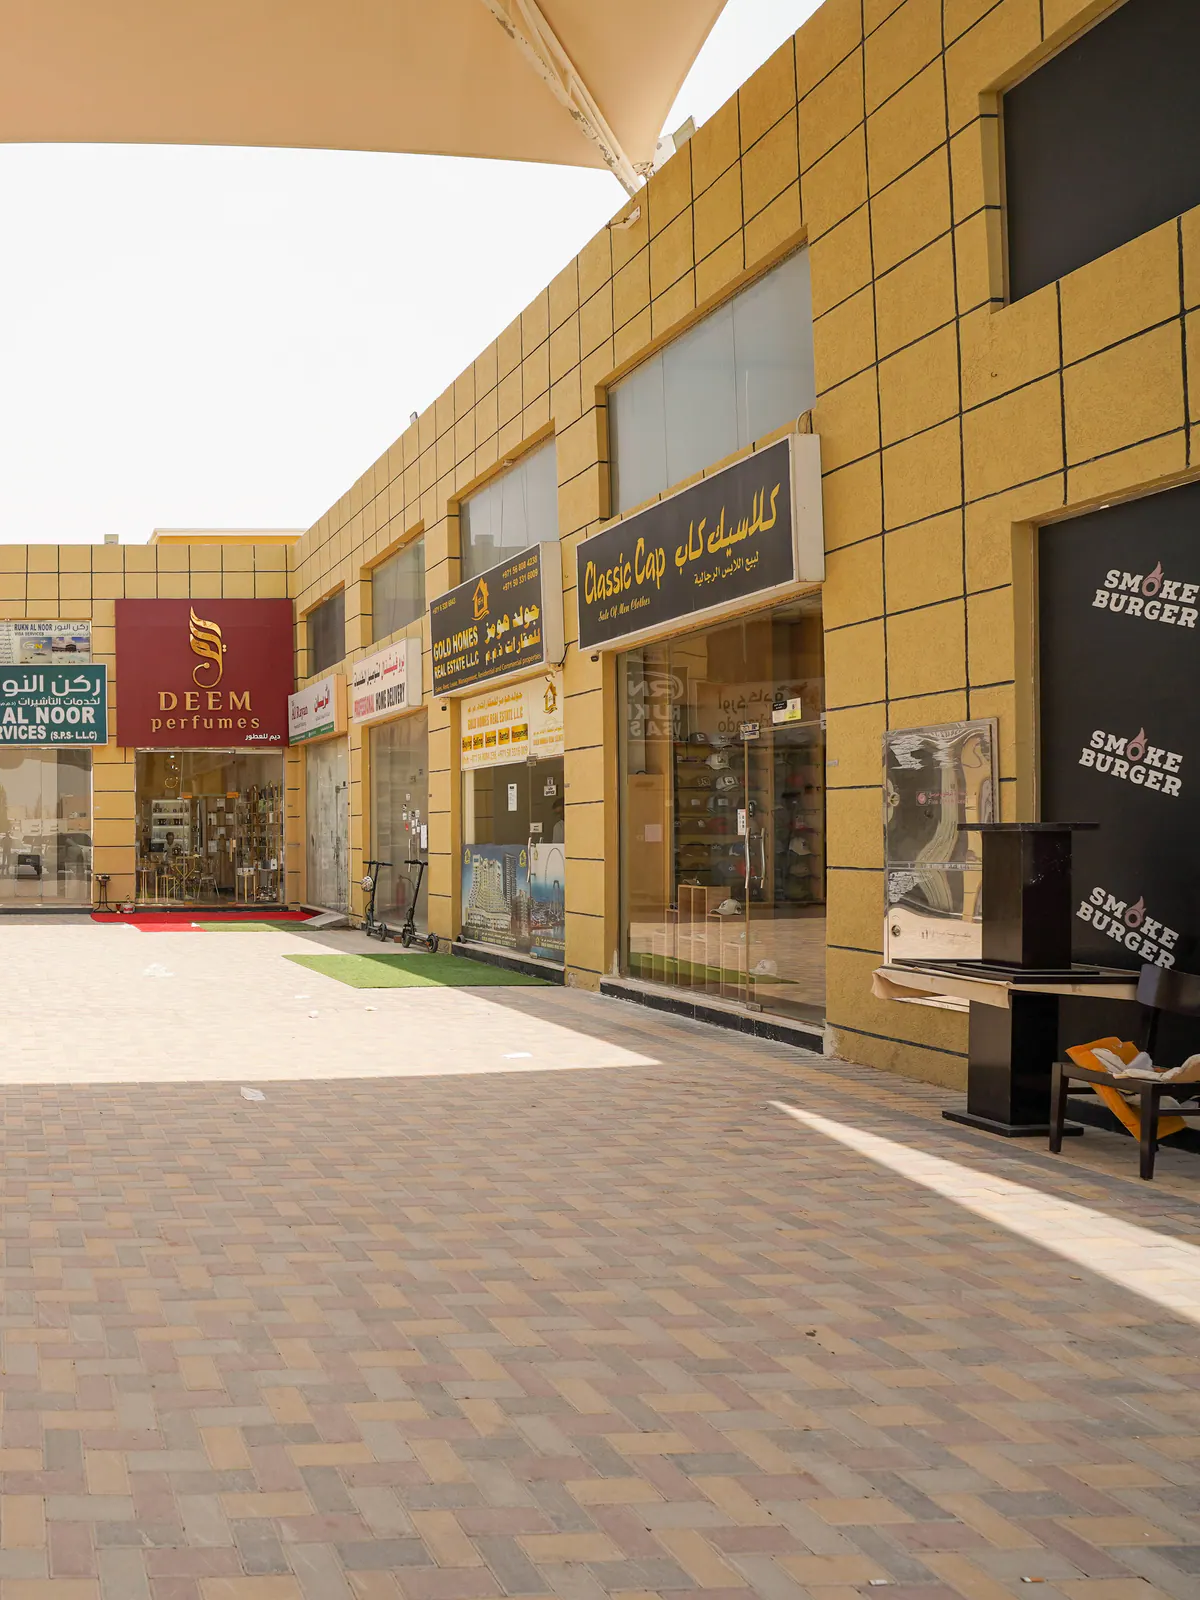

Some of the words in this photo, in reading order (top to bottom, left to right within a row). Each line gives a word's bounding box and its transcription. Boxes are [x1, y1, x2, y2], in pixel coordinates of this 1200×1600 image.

[707, 483, 781, 559] كلاسيك
[675, 517, 707, 576] كاب
[584, 552, 631, 605] Classic
[634, 537, 666, 590] Cap
[1104, 564, 1200, 604] SMOKE
[512, 604, 540, 629] جولد
[1091, 589, 1199, 629] BURGER
[14, 623, 29, 631] RUKN
[30, 623, 37, 631] AL
[38, 623, 53, 631] NOOR
[484, 613, 510, 645] هومز
[433, 637, 452, 662] GOLD
[452, 625, 479, 654] HOMES
[434, 665, 447, 679] REAL
[447, 655, 466, 676] ESTATE
[17, 696, 62, 707] التأشيرات
[51, 674, 100, 697] ركن
[63, 697, 100, 706] لخدمات
[157, 690, 252, 711] DEEM
[2, 707, 29, 724] AL
[36, 706, 96, 724] NOOR
[150, 714, 260, 733] perfumes
[245, 733, 269, 741] للعطور
[1089, 729, 1184, 774] SMOKE
[1078, 748, 1182, 797] BURGER
[1088, 886, 1180, 950] SMOKE
[1076, 901, 1176, 970] BURGER
